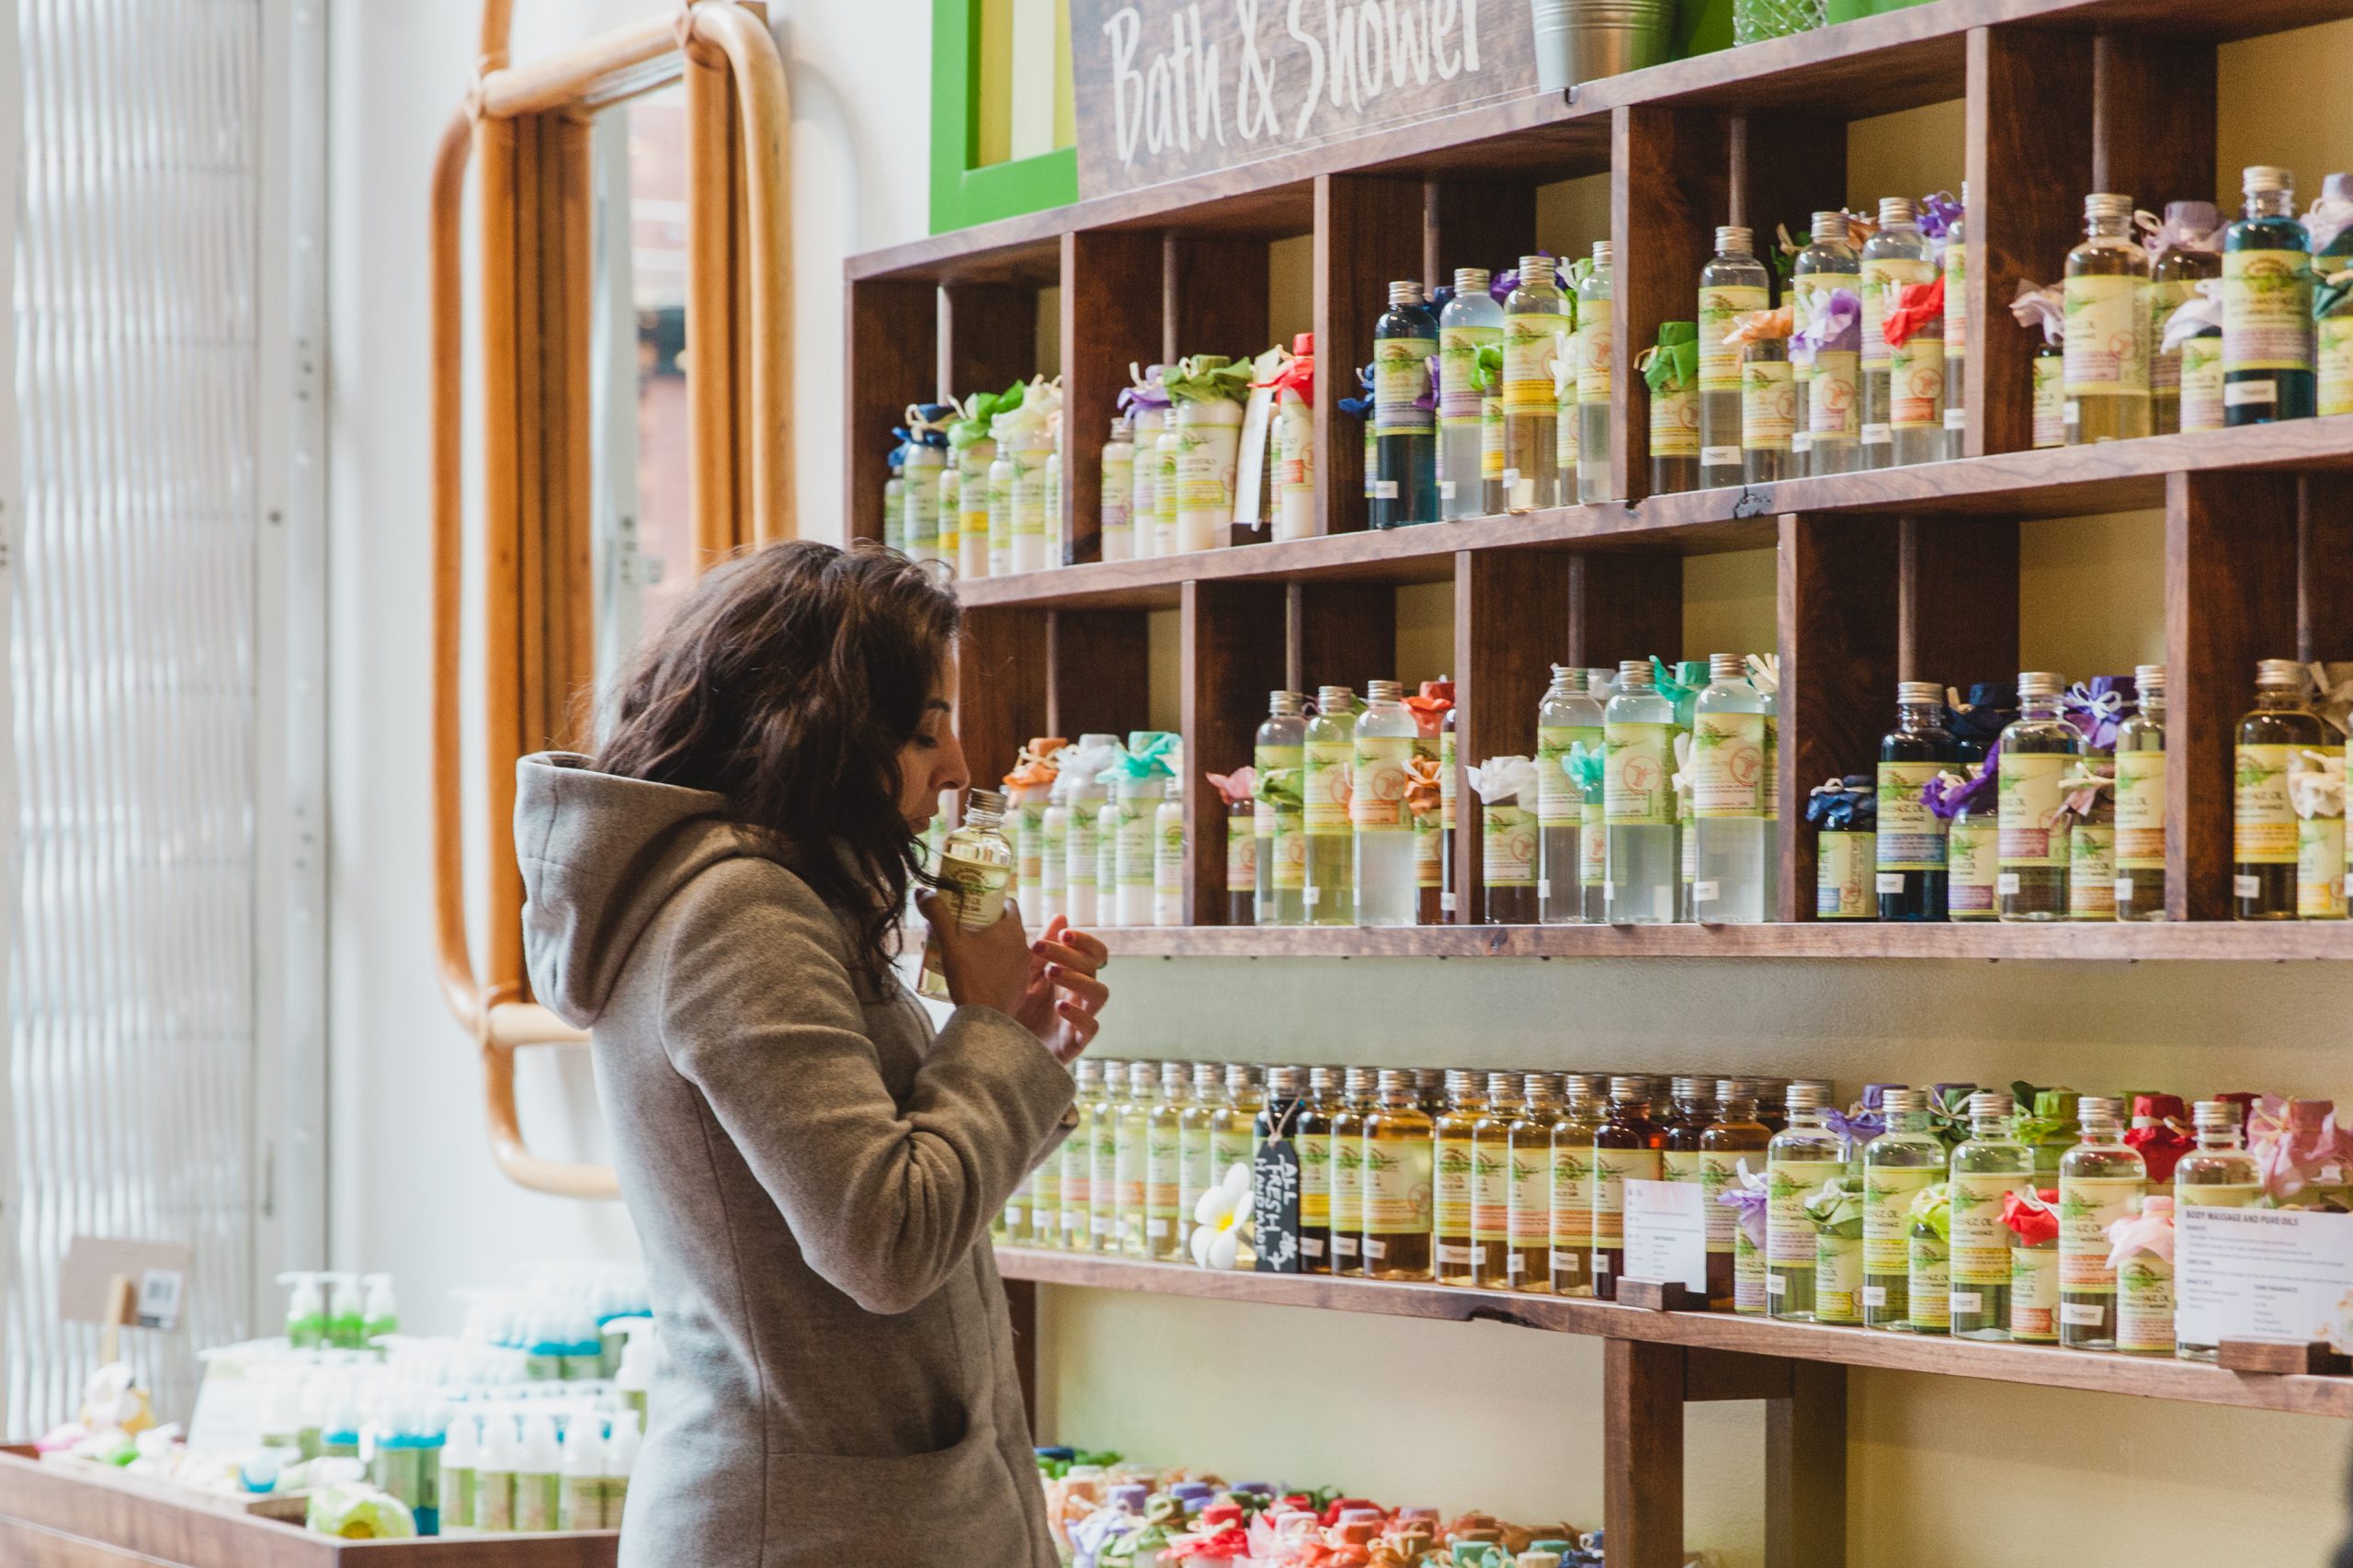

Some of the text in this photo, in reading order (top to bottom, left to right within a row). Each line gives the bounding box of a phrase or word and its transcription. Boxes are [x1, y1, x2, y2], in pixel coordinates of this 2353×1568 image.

[1103, 0, 1481, 171] Bath & Shower
[1264, 1164, 1283, 1232] FRESH
[1278, 1153, 1298, 1206] ALL
[2207, 1211, 2241, 1222] MASSAGE
[2244, 1213, 2259, 1223] AND
